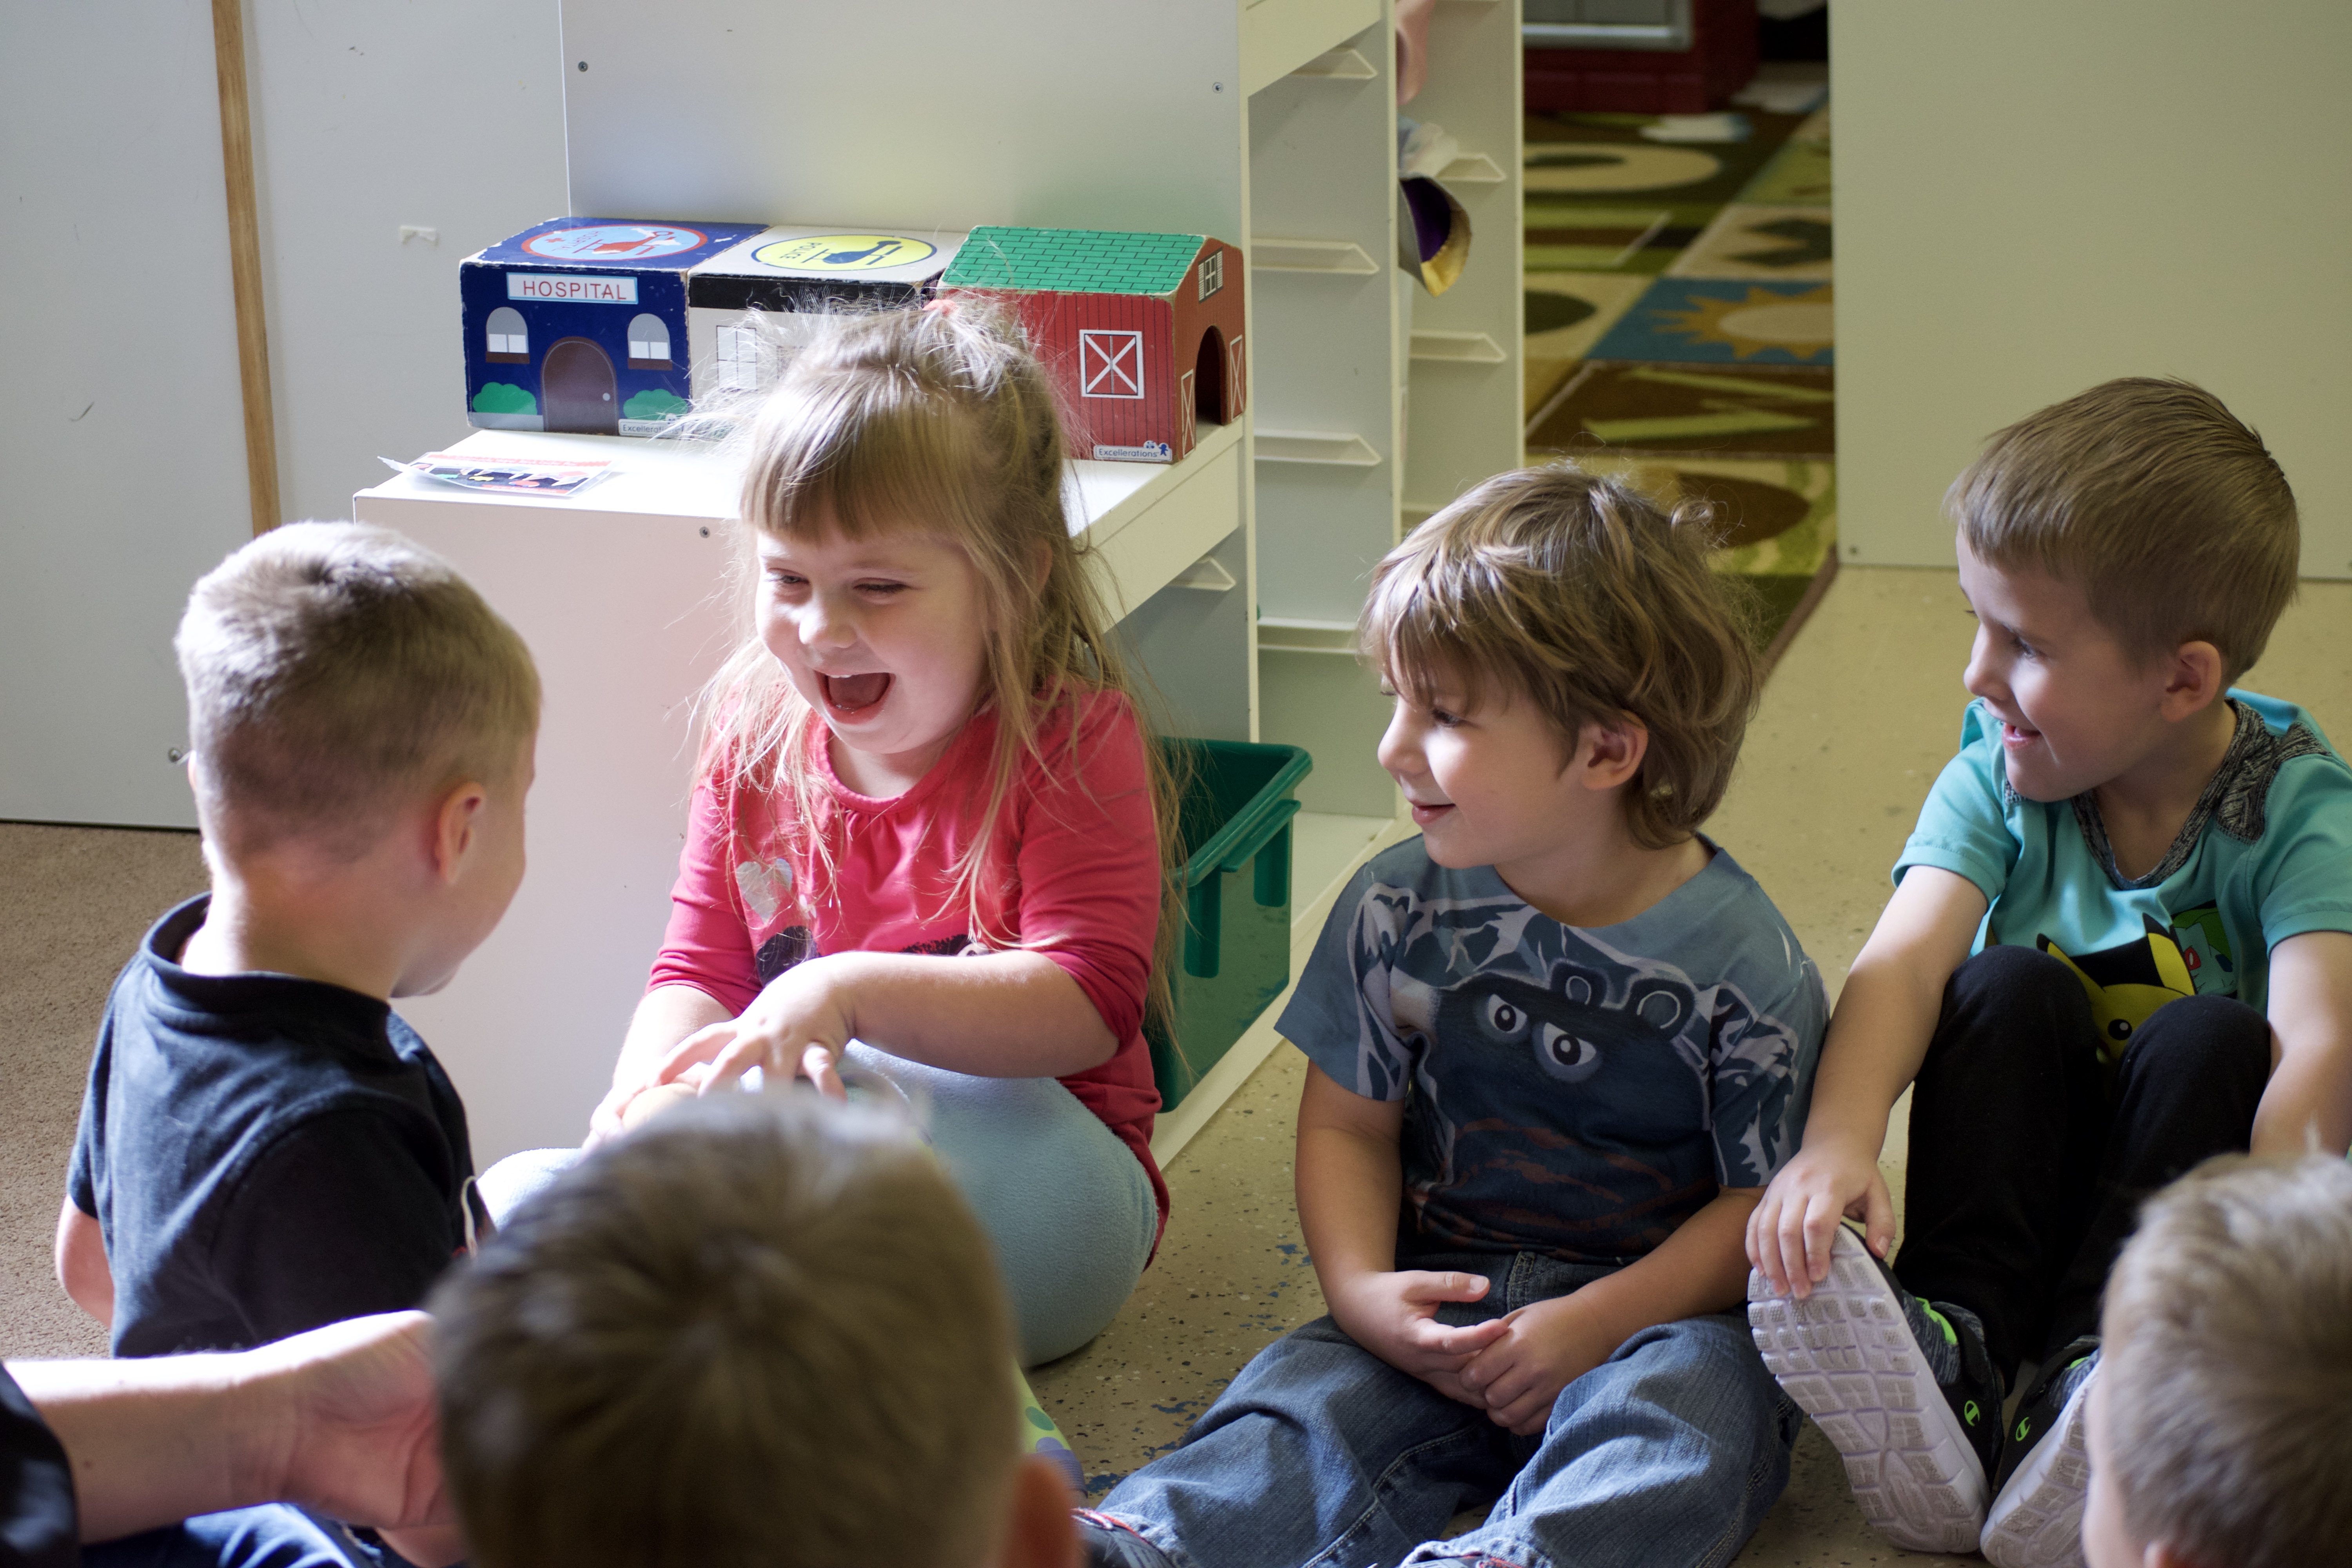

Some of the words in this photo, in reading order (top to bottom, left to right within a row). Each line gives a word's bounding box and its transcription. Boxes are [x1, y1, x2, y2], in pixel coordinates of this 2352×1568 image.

[779, 242, 822, 259] POLICE
[524, 281, 626, 299] HOSPITAL
[1098, 448, 1158, 457] Excellerations
